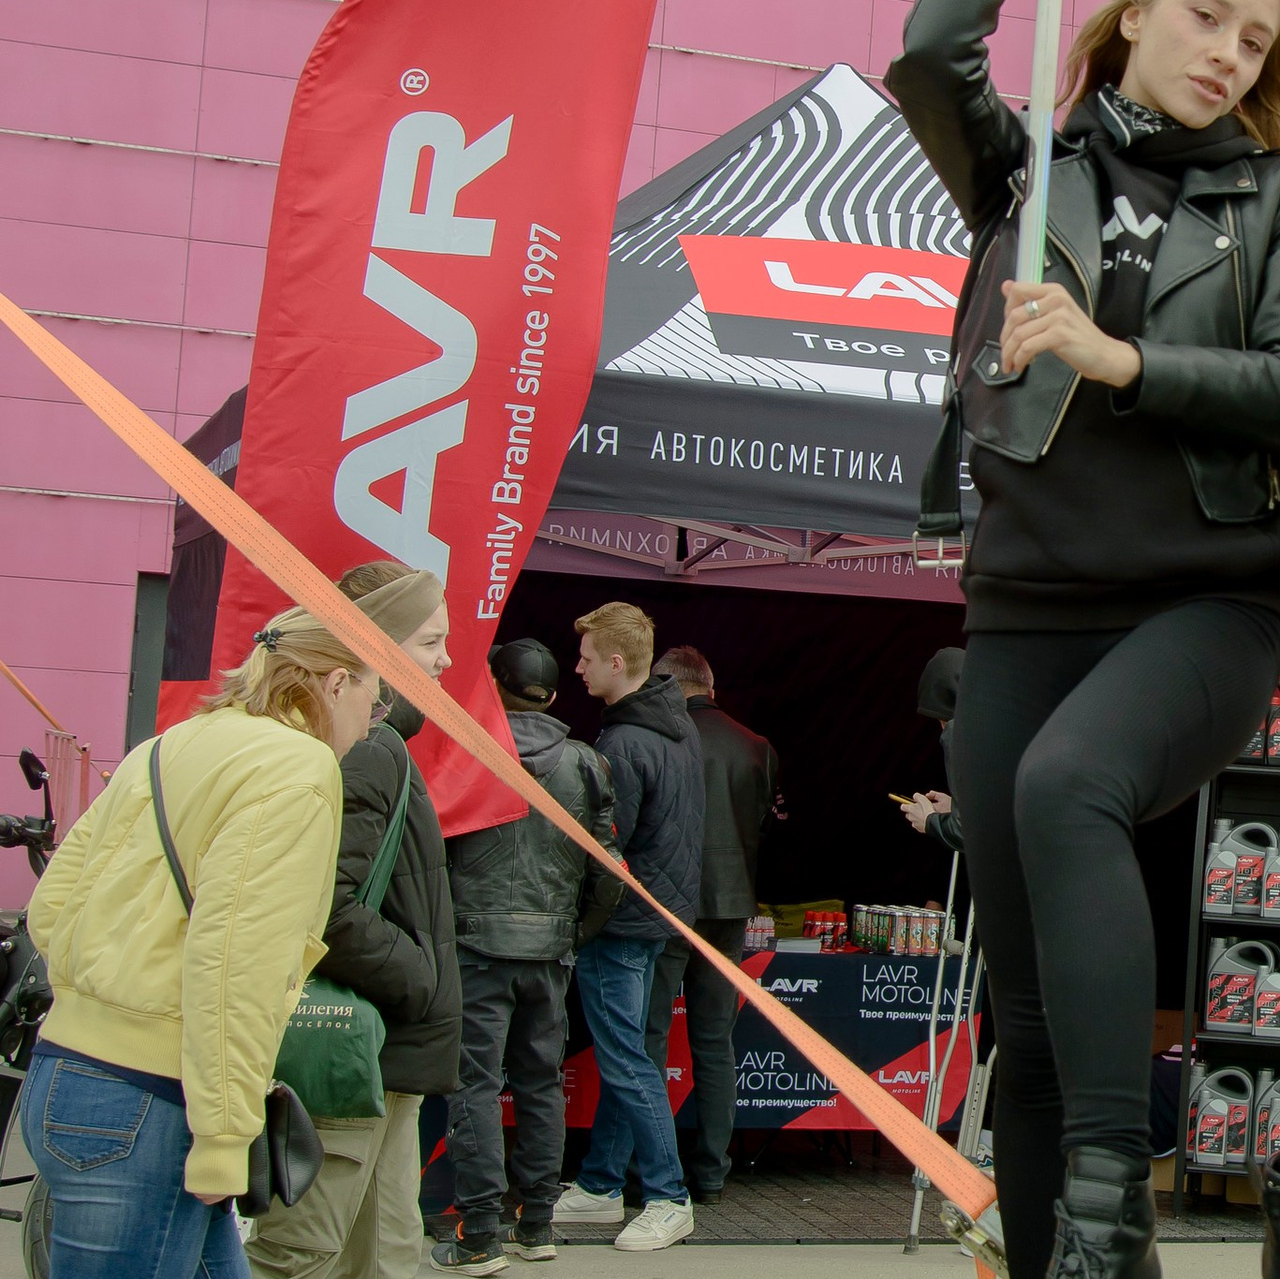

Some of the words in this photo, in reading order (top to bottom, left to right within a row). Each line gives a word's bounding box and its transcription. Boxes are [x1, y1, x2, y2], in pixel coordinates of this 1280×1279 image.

[521, 223, 562, 299] 1997
[763, 260, 959, 309] LAV
[333, 110, 515, 590] AVR
[516, 305, 551, 397] since
[792, 331, 906, 357] Твое
[490, 401, 536, 504] Brand
[651, 430, 903, 484] АВТОКОСМЕТИКА
[477, 511, 525, 620] Family
[862, 985, 972, 1007] MOTOLNE
[863, 964, 918, 983] LAVR
[859, 1009, 884, 1019] Твое
[734, 1051, 786, 1069] AVR
[752, 1098, 837, 1108] преимущество!
